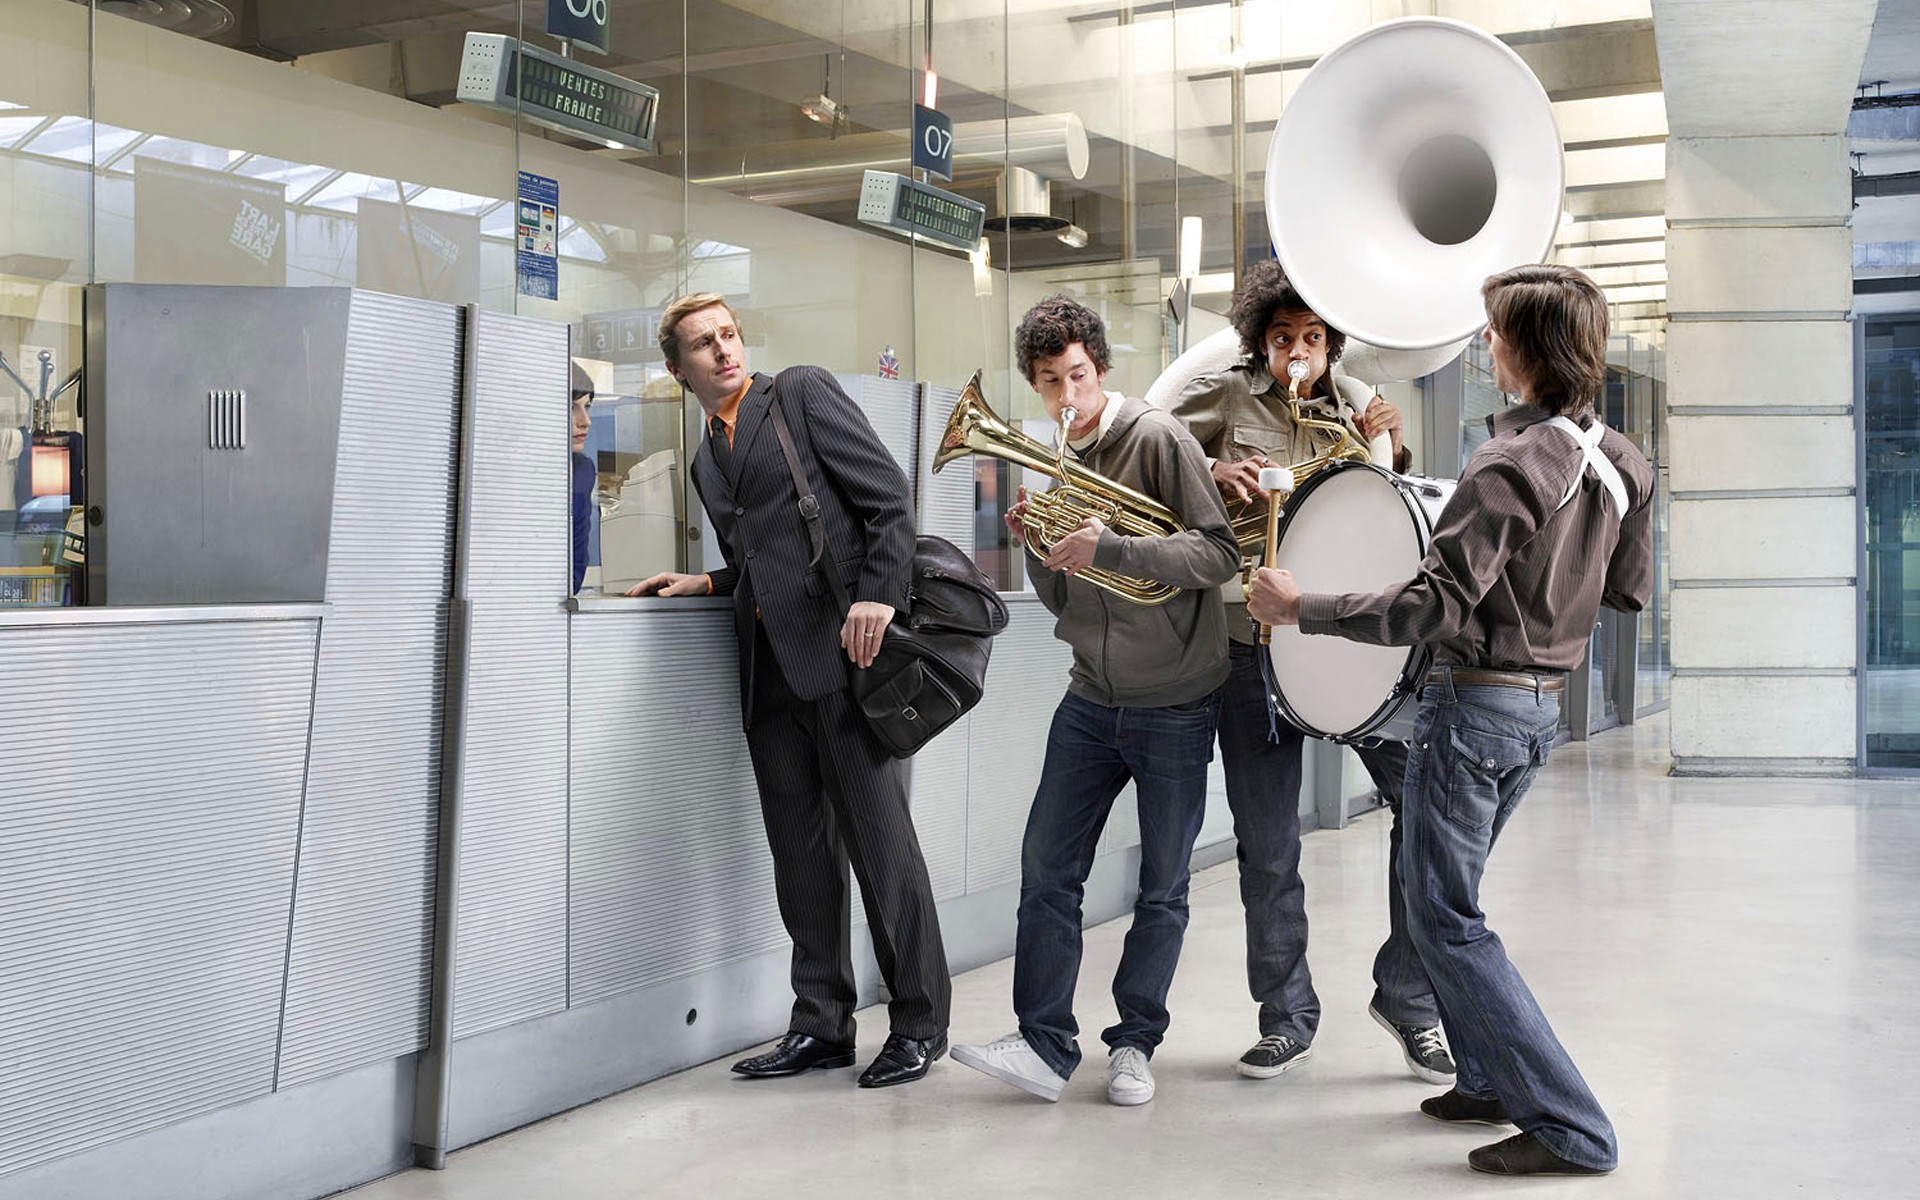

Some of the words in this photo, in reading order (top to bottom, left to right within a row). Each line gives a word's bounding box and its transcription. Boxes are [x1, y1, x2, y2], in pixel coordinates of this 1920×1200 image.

[560, 71, 605, 99] VENTES
[556, 95, 602, 122] FRANCE
[925, 126, 952, 159] 07
